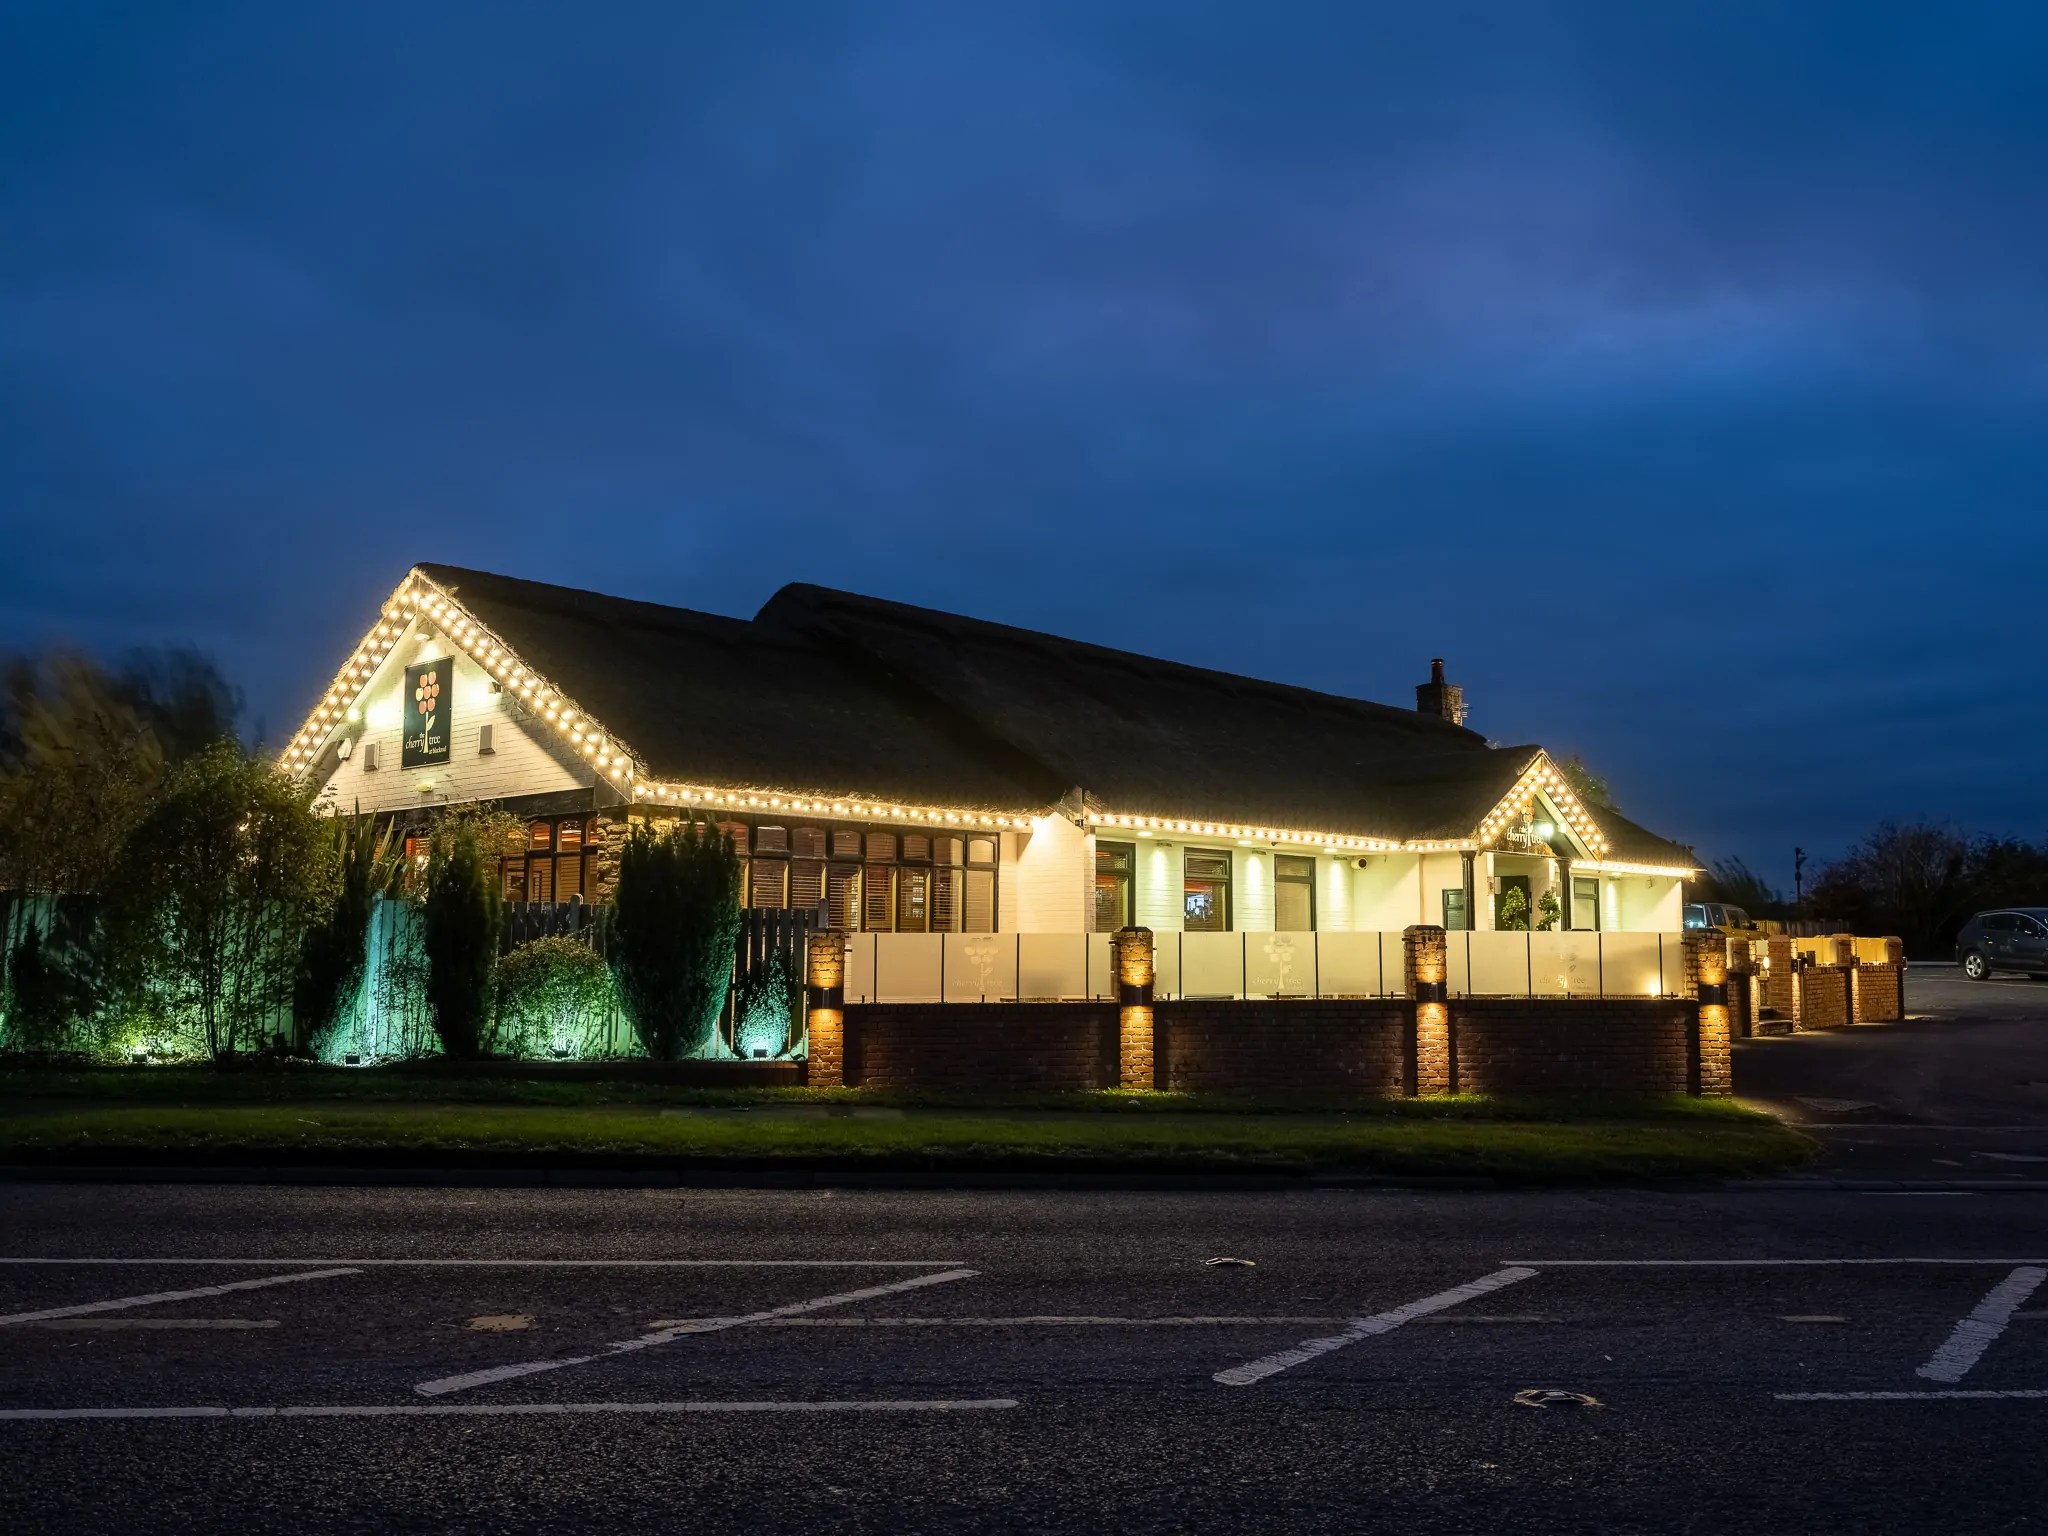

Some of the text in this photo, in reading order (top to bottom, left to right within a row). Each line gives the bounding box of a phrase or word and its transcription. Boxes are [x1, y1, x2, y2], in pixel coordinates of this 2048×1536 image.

[405, 735, 441, 753] cherry tree
[1506, 826, 1528, 849] cherry
[1252, 976, 1279, 990] cherry
[1285, 976, 1303, 985] tree
